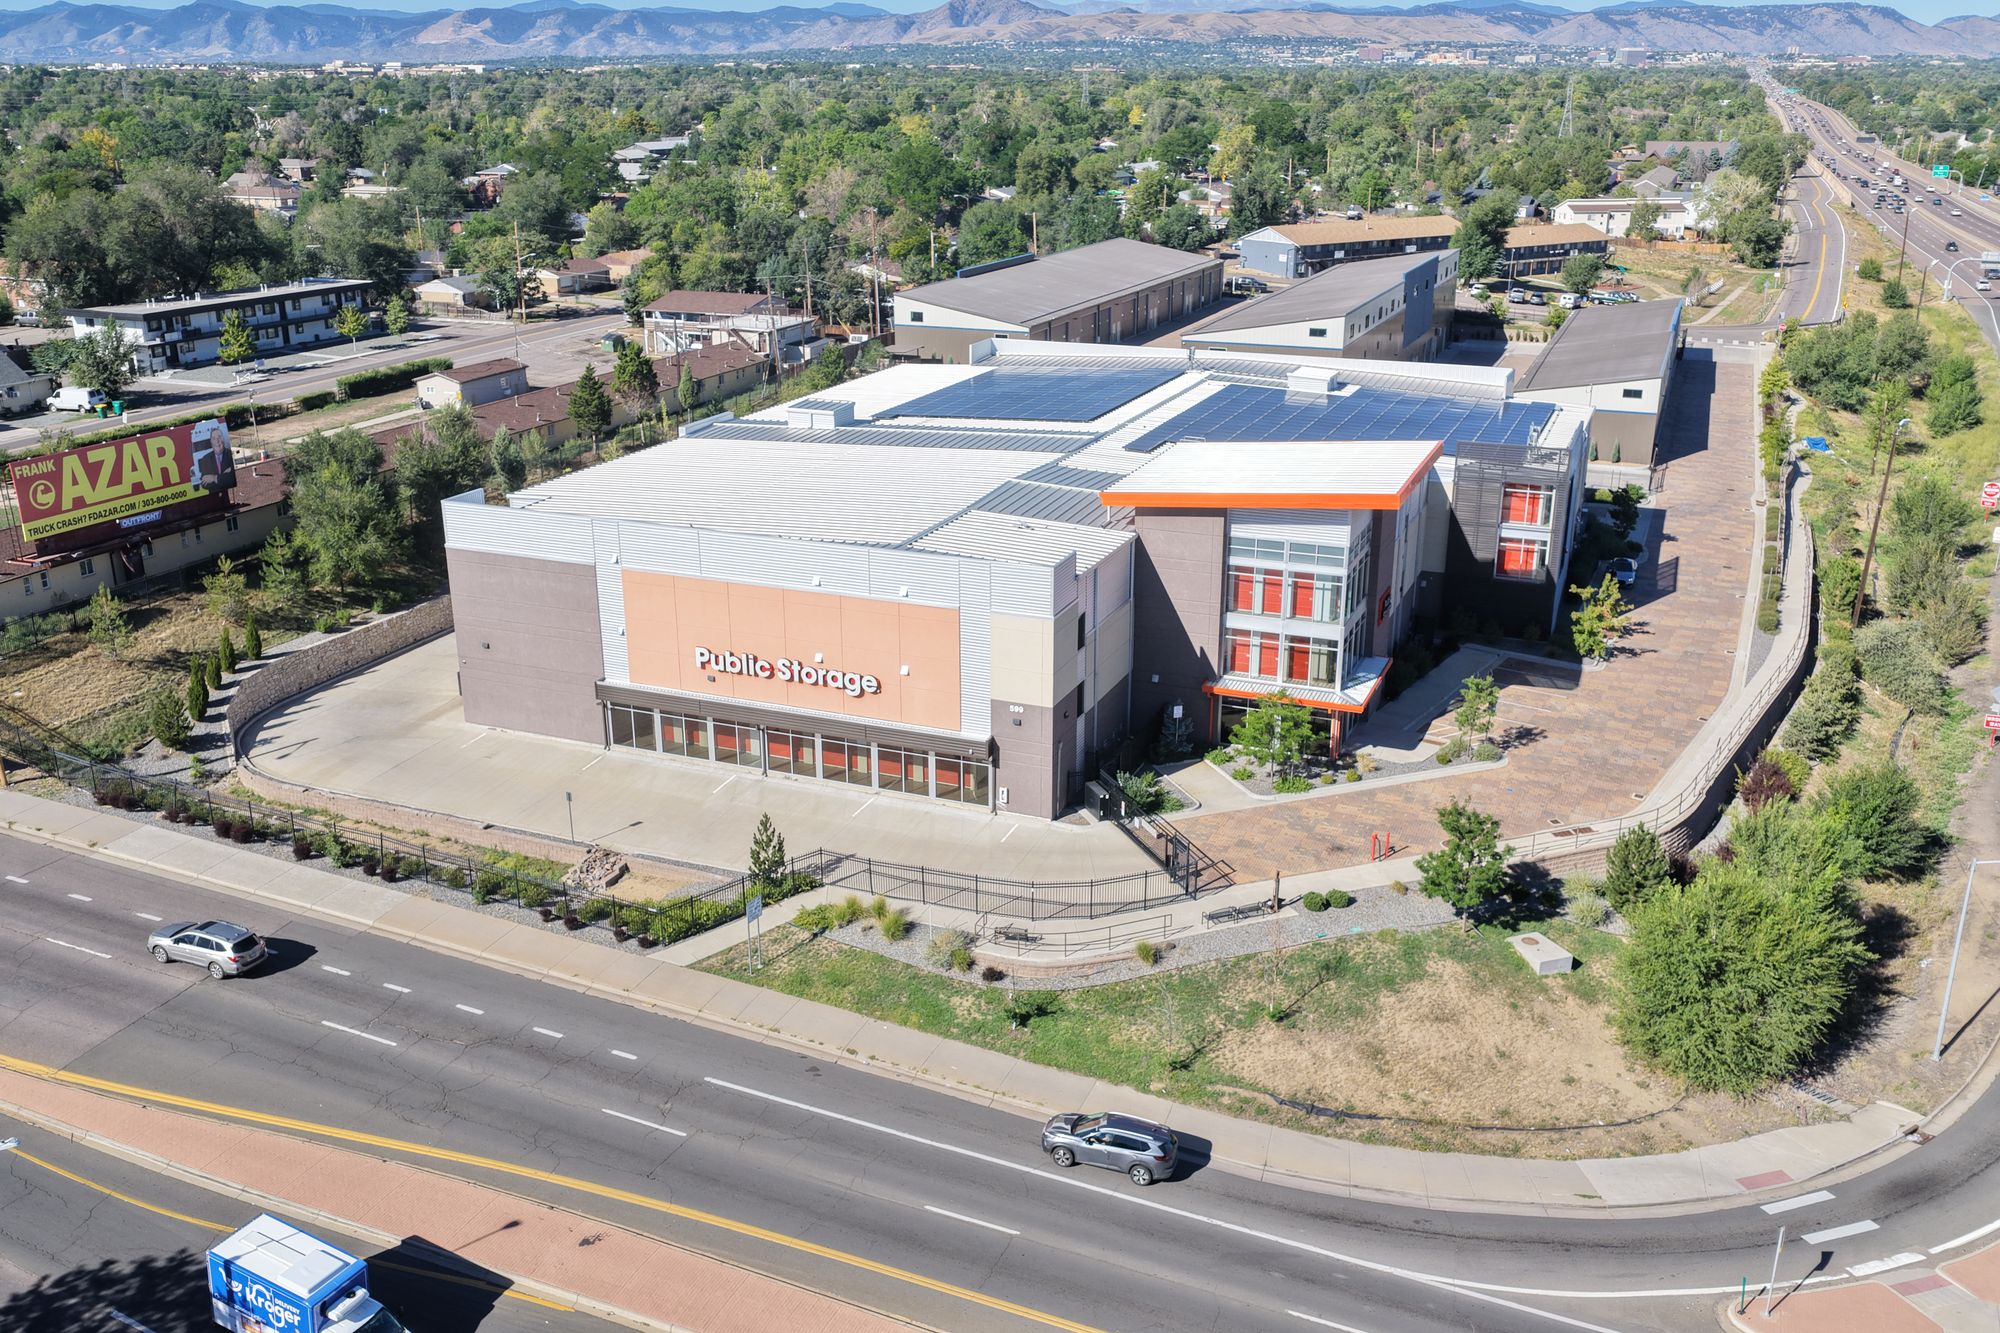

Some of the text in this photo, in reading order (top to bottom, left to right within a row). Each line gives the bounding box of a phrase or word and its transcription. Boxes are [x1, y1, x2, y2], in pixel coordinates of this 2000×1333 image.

[14, 458, 57, 480] FRANK
[61, 435, 181, 511] AZAR
[28, 521, 56, 537] TRUCK
[56, 515, 87, 530] CRASH?
[88, 501, 137, 522] FDAZAR.COM
[141, 489, 188, 508] 303-800-0000
[121, 511, 161, 527] OUTFRONT
[695, 646, 880, 697] Public Storage
[245, 1284, 301, 1328] Kroger
